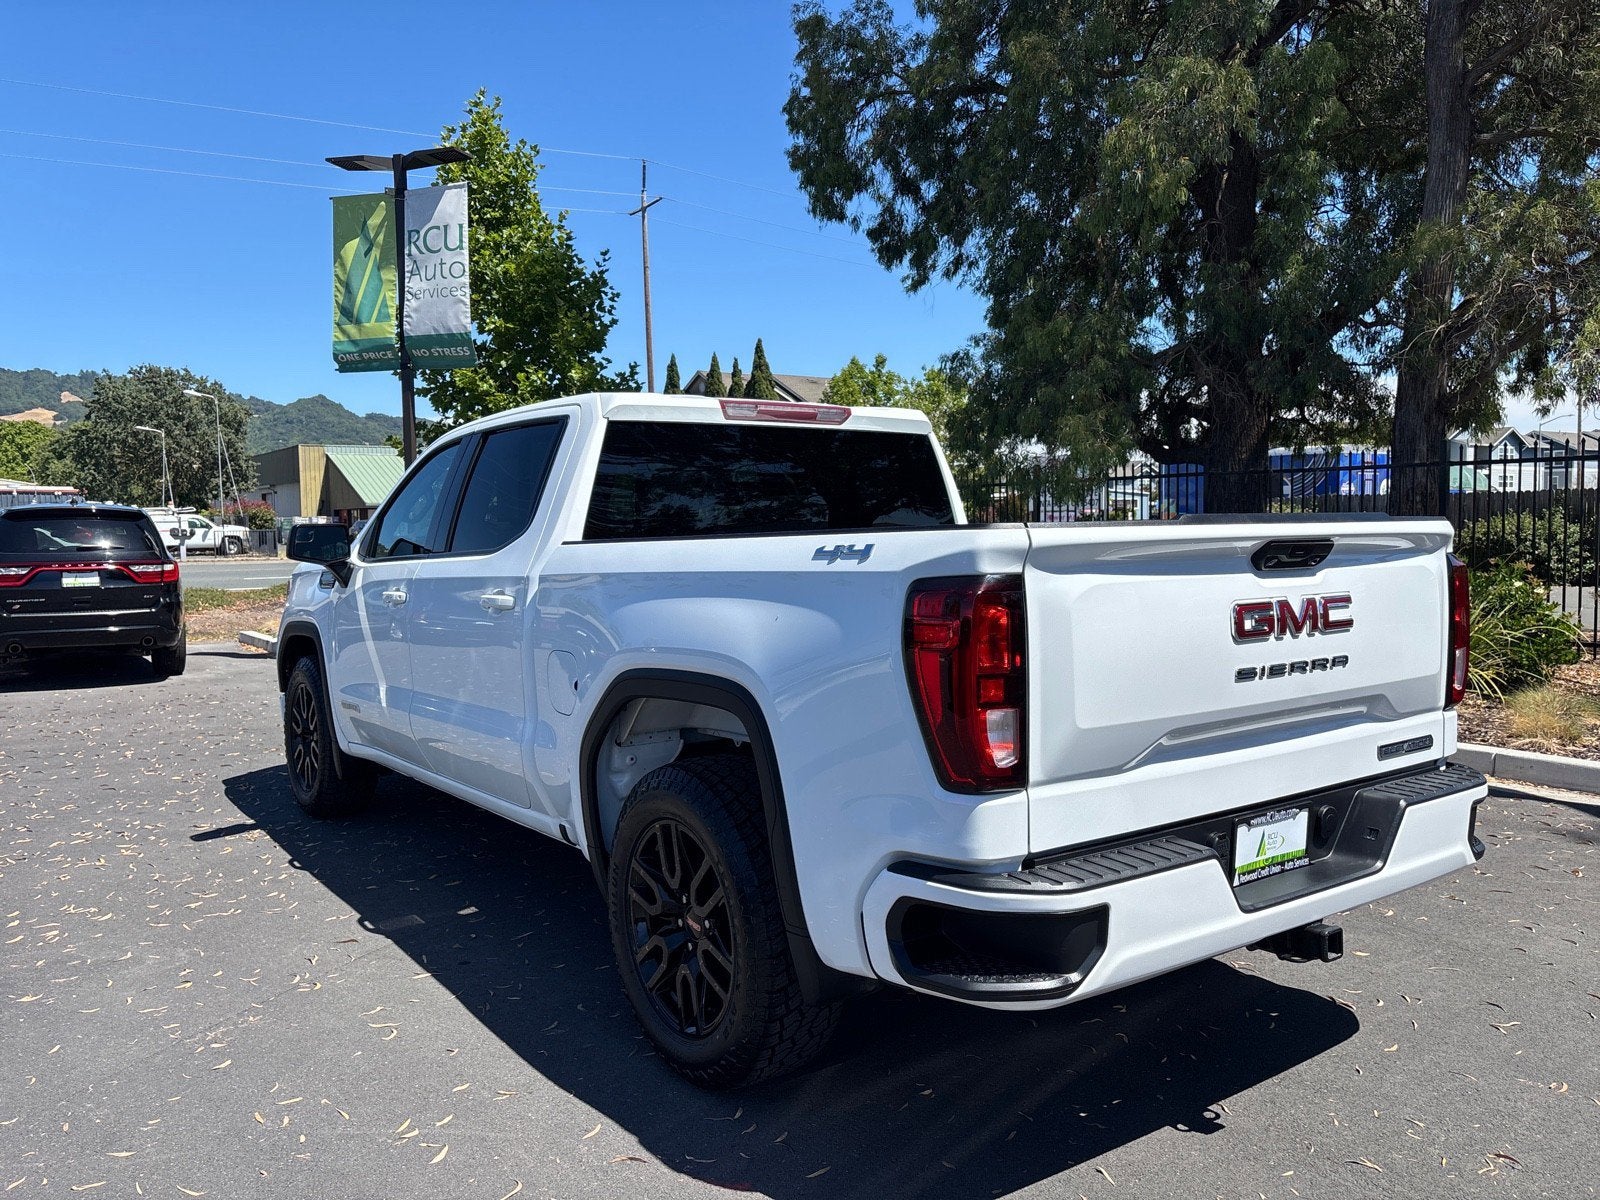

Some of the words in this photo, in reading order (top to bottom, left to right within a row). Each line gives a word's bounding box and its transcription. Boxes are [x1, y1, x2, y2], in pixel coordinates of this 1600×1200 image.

[406, 222, 465, 257] RCU
[407, 258, 466, 284] Auto
[405, 284, 468, 301] Services
[337, 352, 361, 362] ONE
[361, 350, 395, 361] PRICE
[411, 348, 430, 357] NO
[431, 346, 471, 357] STRESS
[1230, 591, 1354, 644] GMC
[1234, 654, 1349, 683] SIERRA
